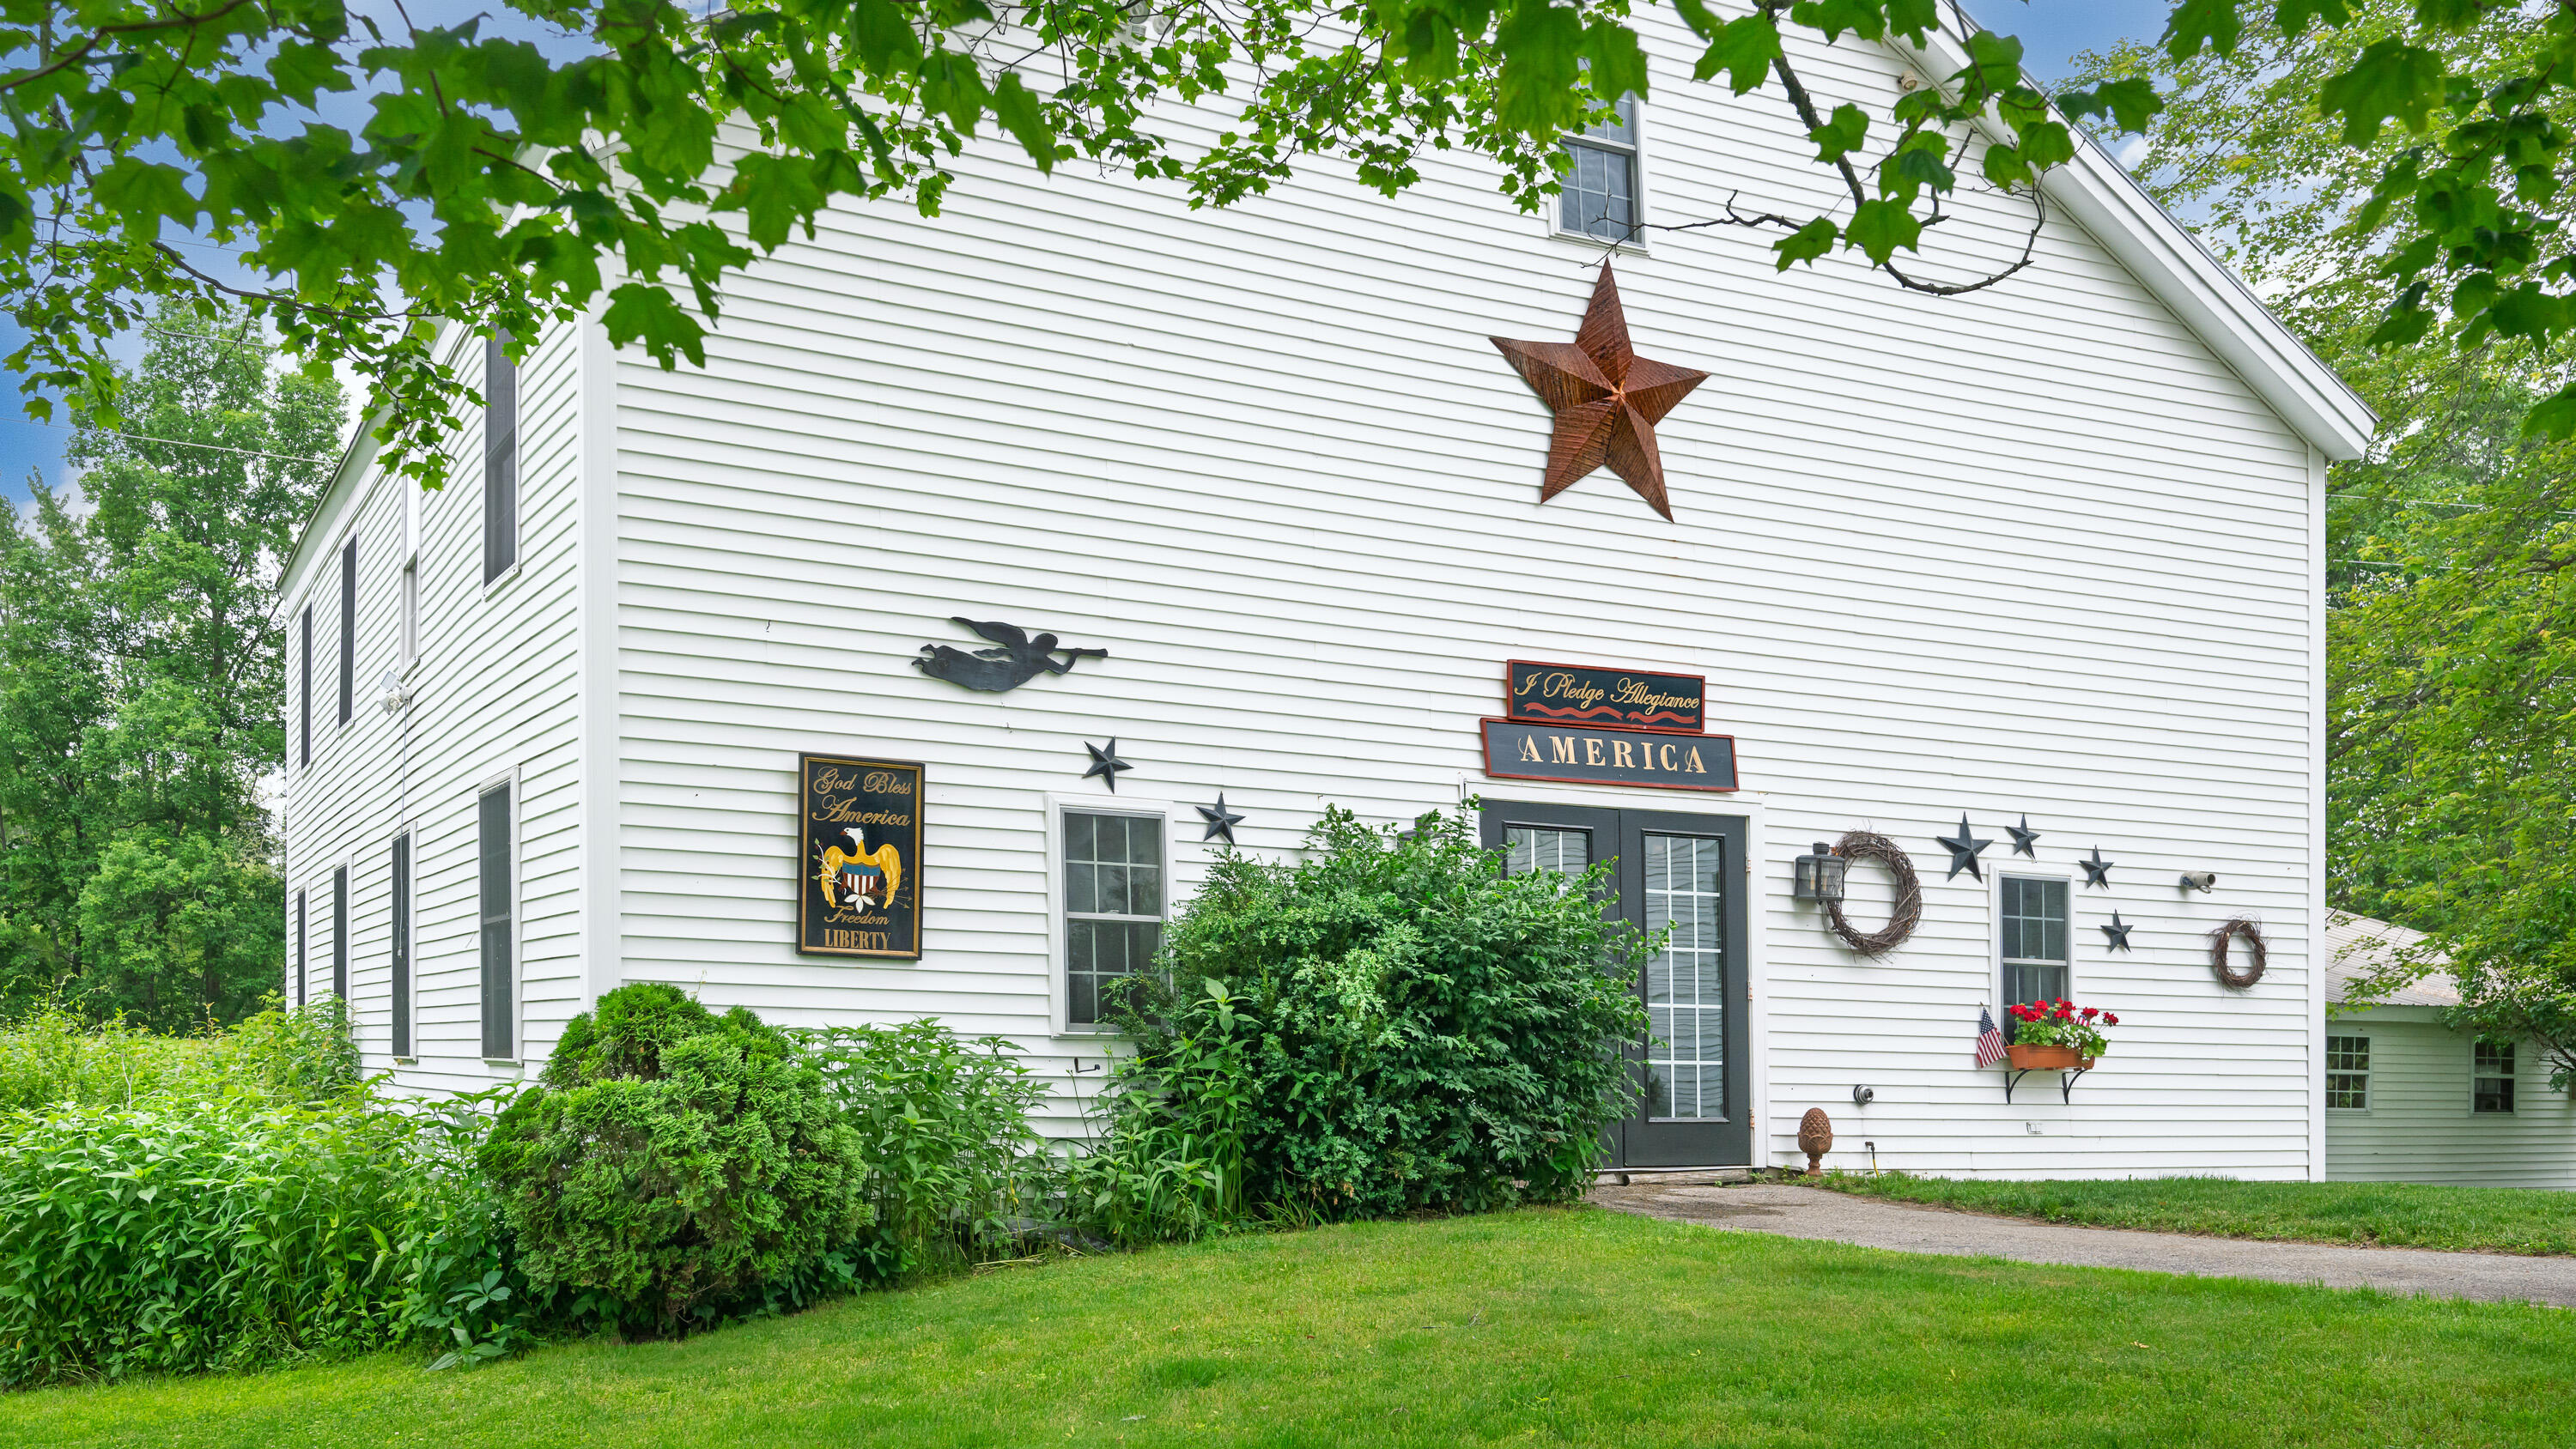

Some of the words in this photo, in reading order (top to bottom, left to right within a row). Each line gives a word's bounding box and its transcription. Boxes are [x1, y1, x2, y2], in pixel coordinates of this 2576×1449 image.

[1514, 671, 1542, 696] I
[1543, 672, 1604, 709] Pledge
[1610, 677, 1700, 715] Allegiance
[1517, 734, 1707, 773] AMERICA
[813, 767, 858, 795] God
[863, 772, 912, 795] Bless
[811, 794, 911, 827] America
[823, 905, 890, 925] Freedom
[824, 928, 891, 950] LIBERTY
